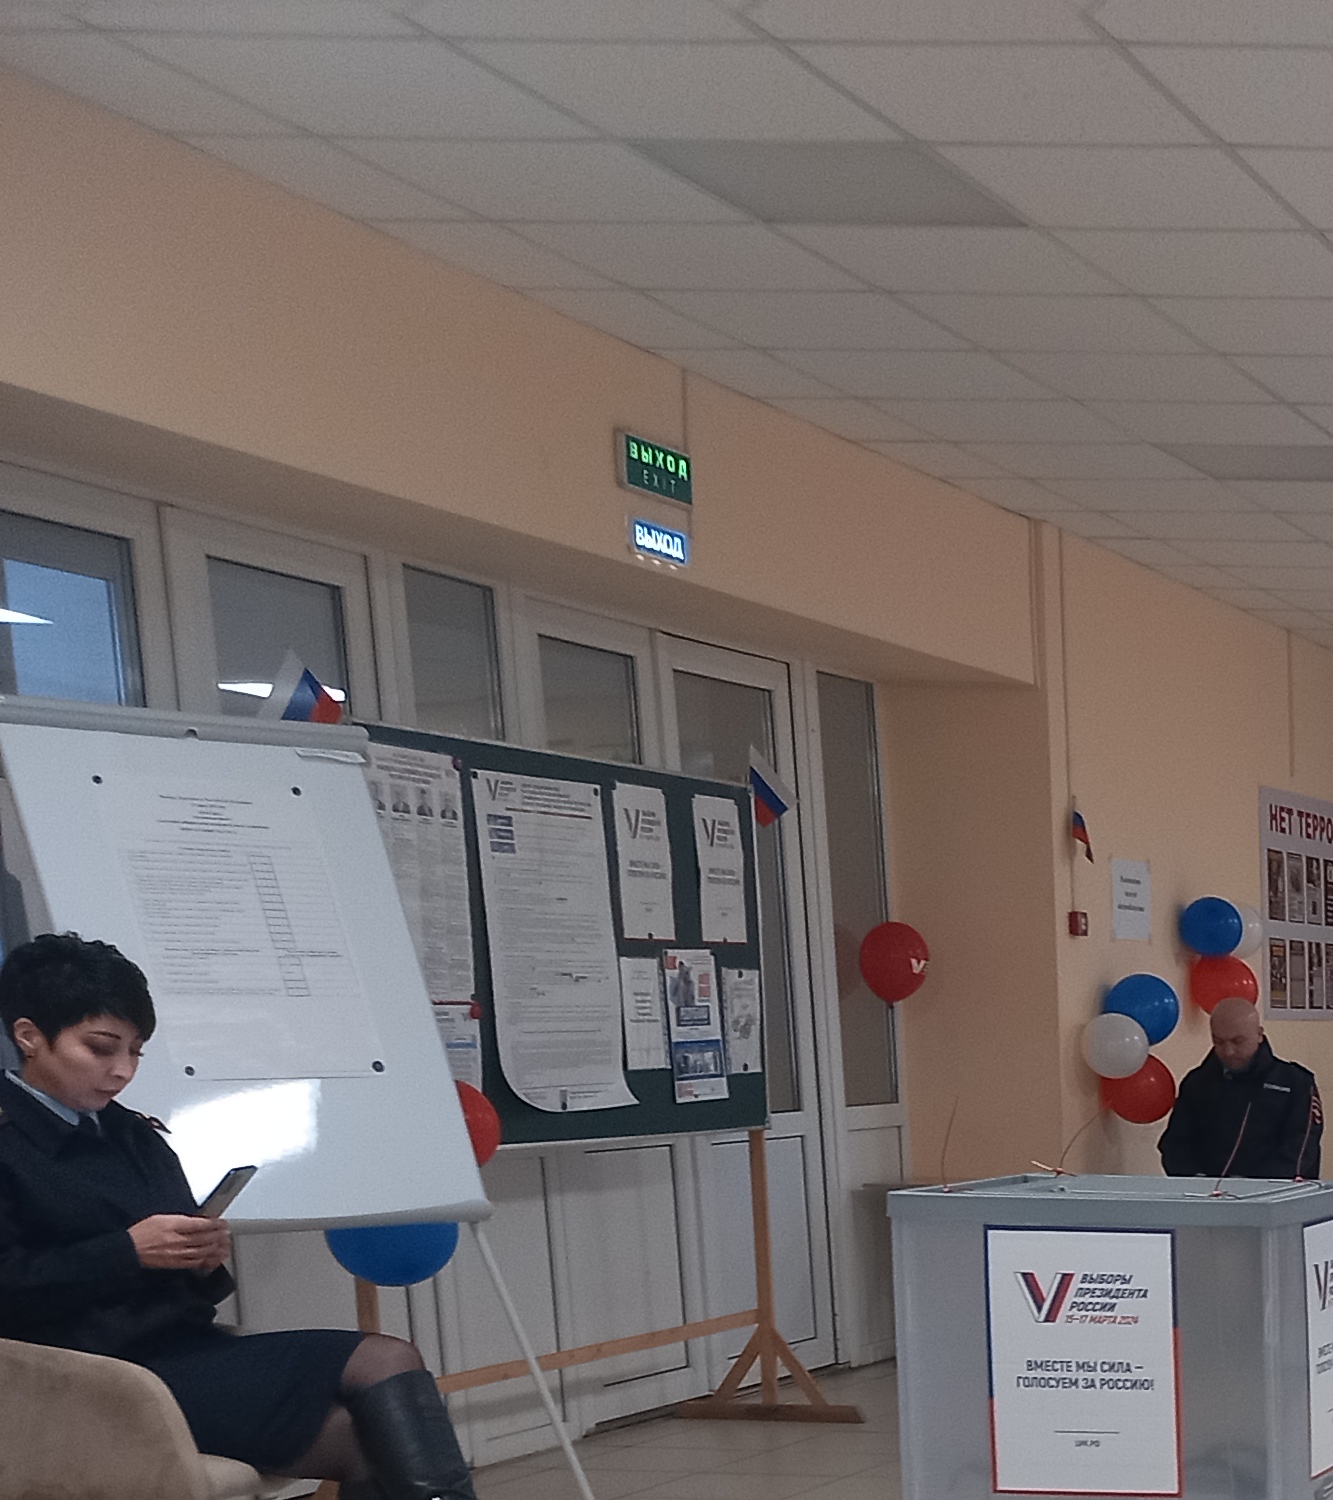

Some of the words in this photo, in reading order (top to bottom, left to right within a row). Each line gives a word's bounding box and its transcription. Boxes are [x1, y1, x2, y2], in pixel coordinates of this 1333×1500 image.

[629, 440, 689, 482] ВЫХОД
[643, 468, 677, 493] EXIT
[634, 522, 685, 561] ВЫХОД
[1268, 803, 1295, 836] НЕТ
[1079, 1272, 1135, 1286] ВЫБОРЫ
[1072, 1286, 1149, 1300] ПРЕЗИДЕНТА
[1067, 1300, 1118, 1314] РОССИИ
[1088, 1314, 1119, 1326] МАРТА
[1118, 1314, 1140, 1326] 2024
[1025, 1359, 1073, 1374] ВМЕСТЕ
[1074, 1360, 1098, 1374] МЫ
[1099, 1360, 1134, 1375] СИЛА
[1016, 1375, 1079, 1390] ГОЛОСУЕМ
[1081, 1376, 1098, 1390] ЗА
[1099, 1377, 1155, 1391] РОССИЮ!
